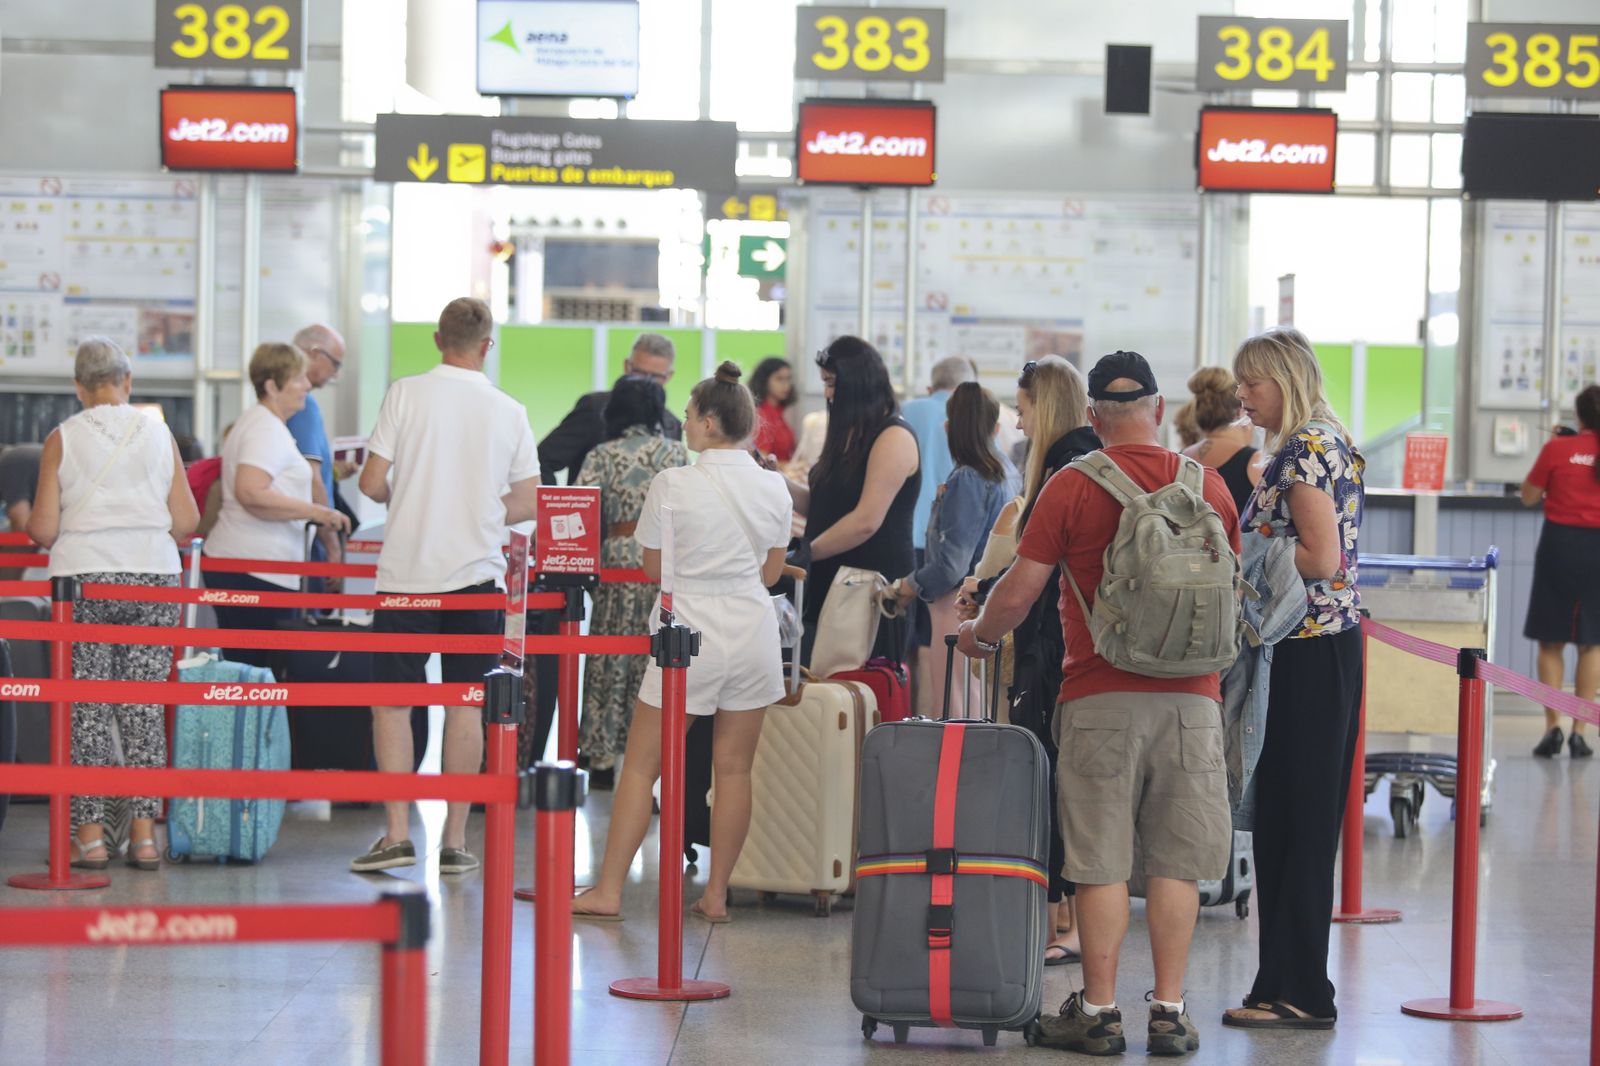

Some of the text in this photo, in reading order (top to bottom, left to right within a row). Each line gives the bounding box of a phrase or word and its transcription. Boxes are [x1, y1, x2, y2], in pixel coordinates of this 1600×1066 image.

[171, 3, 290, 59] 382
[811, 15, 930, 72] 383
[1214, 25, 1335, 82] 384
[1482, 32, 1600, 88] 385
[169, 118, 289, 142] Jet2.com
[806, 131, 928, 156] Jet2.com
[1207, 138, 1328, 164] Jet2.com
[491, 147, 592, 167] Boarding gates
[491, 163, 674, 188] Puertas de embarque
[542, 555, 595, 566] Jet2.com
[199, 592, 260, 604] Jet2.com
[381, 597, 441, 608] Jet2.com
[203, 685, 289, 701] Jet2.com
[86, 909, 238, 941] Jet2.com
